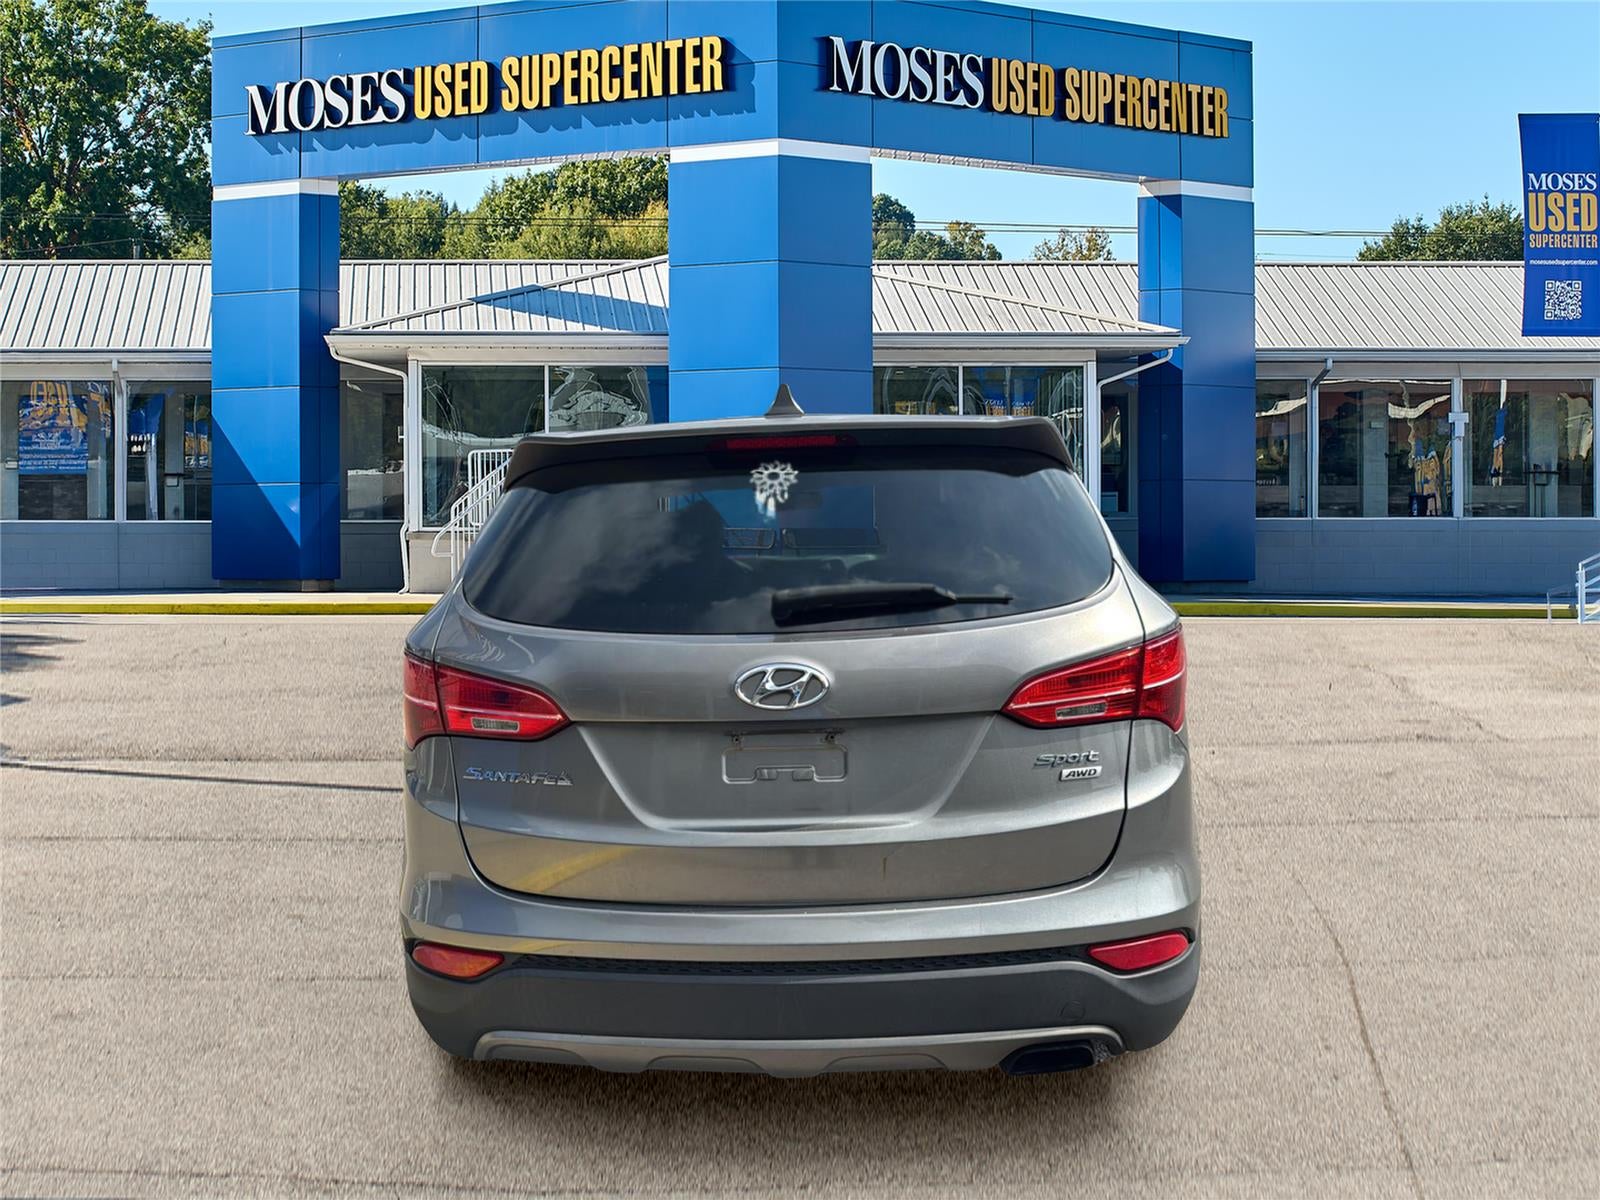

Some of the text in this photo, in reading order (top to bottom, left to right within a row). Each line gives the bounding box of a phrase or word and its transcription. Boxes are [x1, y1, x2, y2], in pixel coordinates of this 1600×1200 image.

[245, 35, 725, 137] MOSES USED SUPERCENTER
[829, 36, 1230, 138] MOSES USED SUPERCENTER
[1527, 173, 1598, 192] MOSES
[1528, 192, 1598, 232] USED
[1529, 233, 1598, 249] SUPERCENTER
[1033, 750, 1100, 768] Sport
[1065, 768, 1097, 778] AWD
